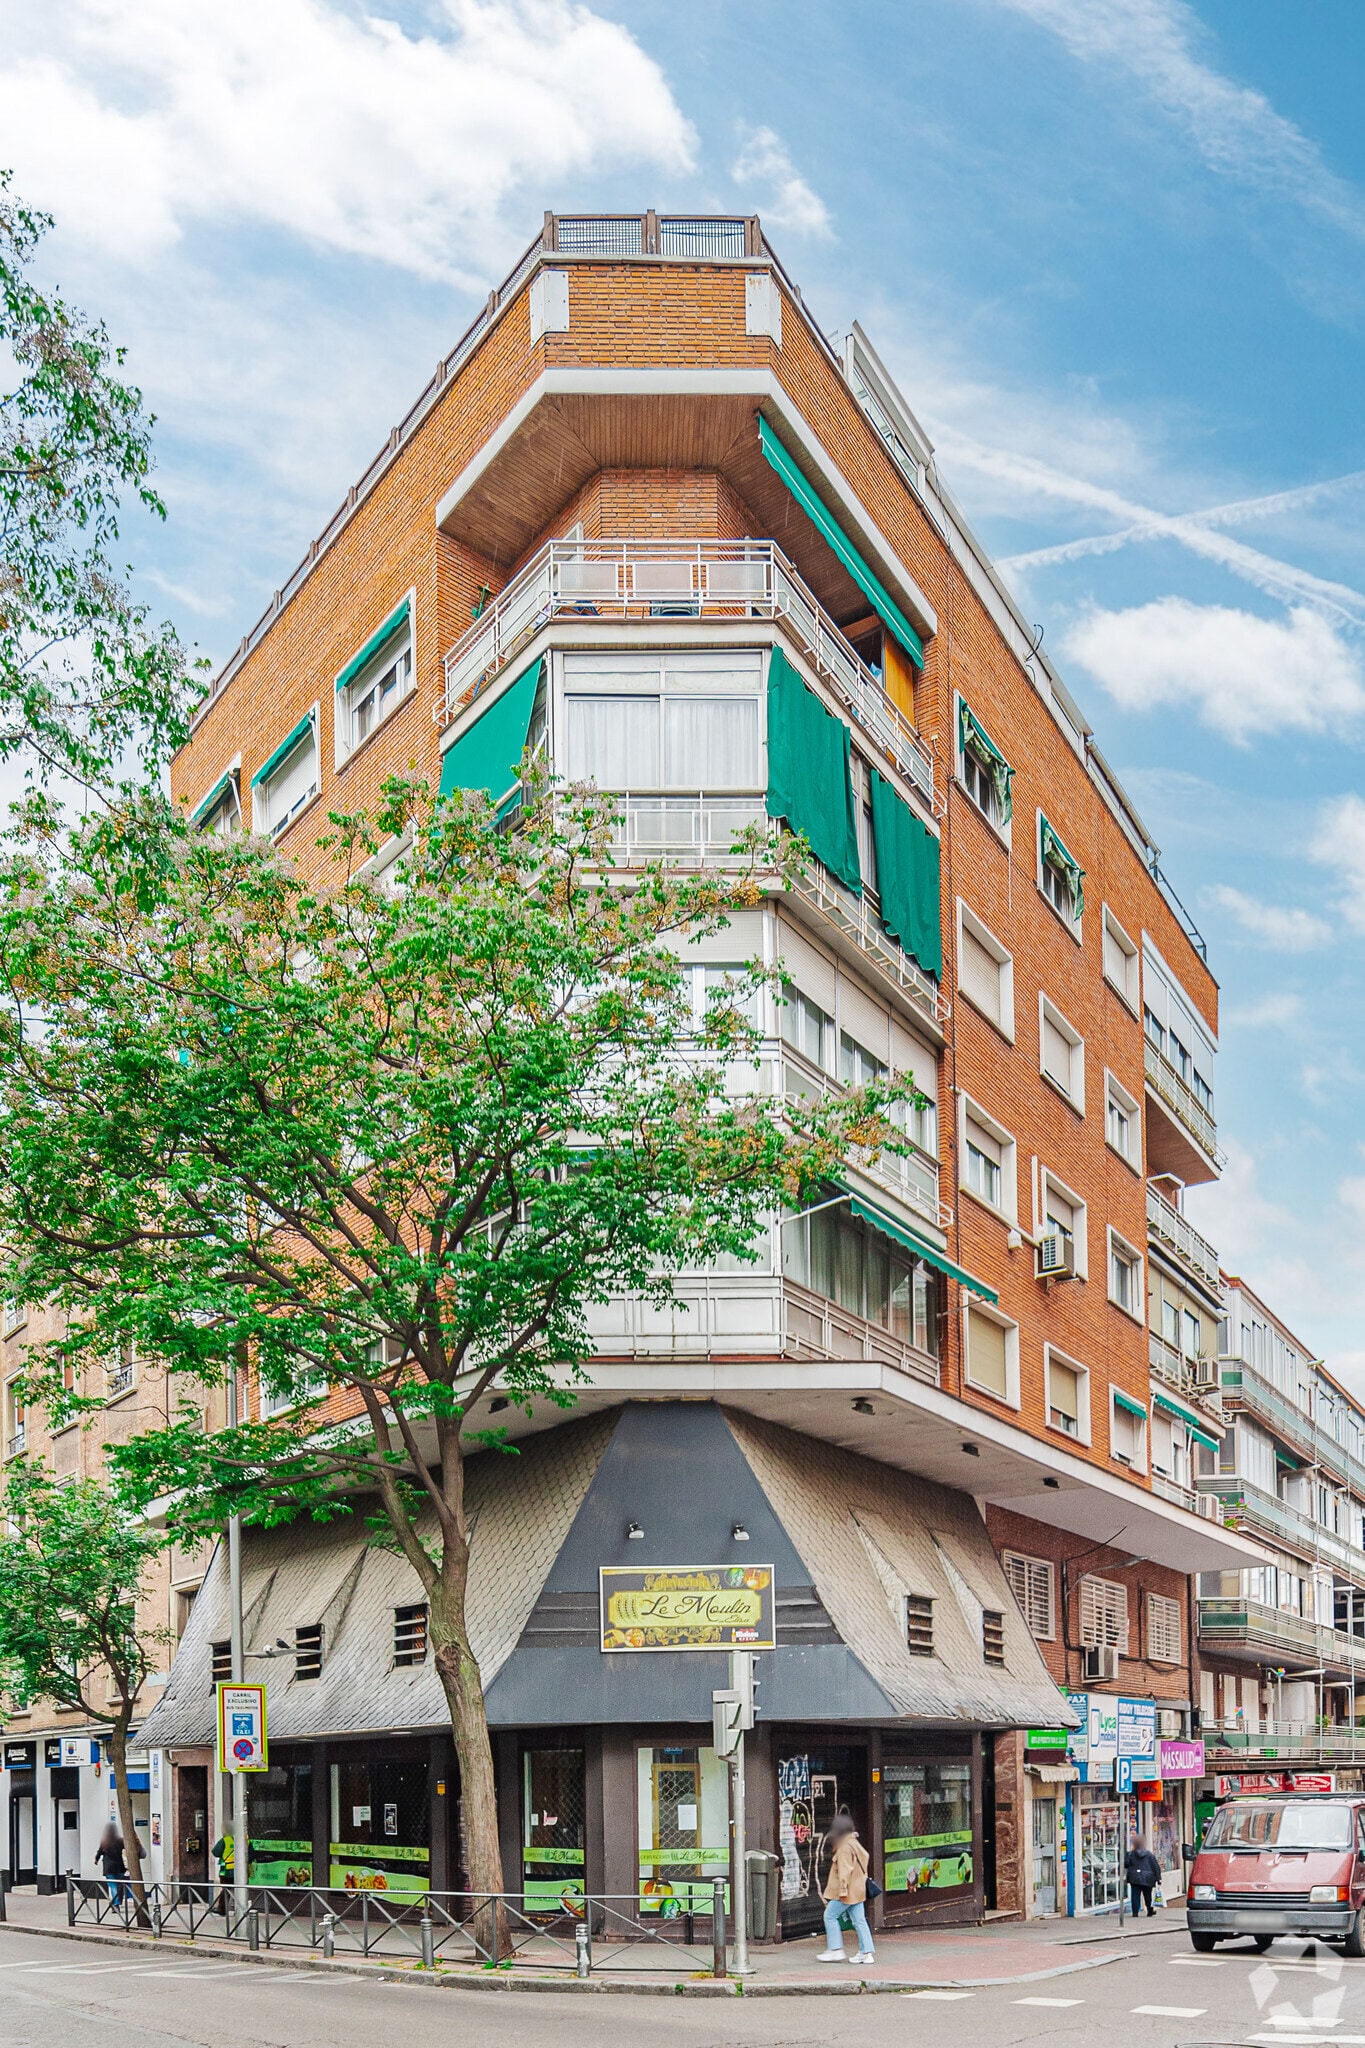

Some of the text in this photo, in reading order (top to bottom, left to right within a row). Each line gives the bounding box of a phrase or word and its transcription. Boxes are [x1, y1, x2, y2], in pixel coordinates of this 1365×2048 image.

[641, 1594, 751, 1622] Le Moulin
[1067, 1695, 1086, 1704] FAX
[1101, 1712, 1117, 1732] Lyca
[1121, 1761, 1130, 1788] P
